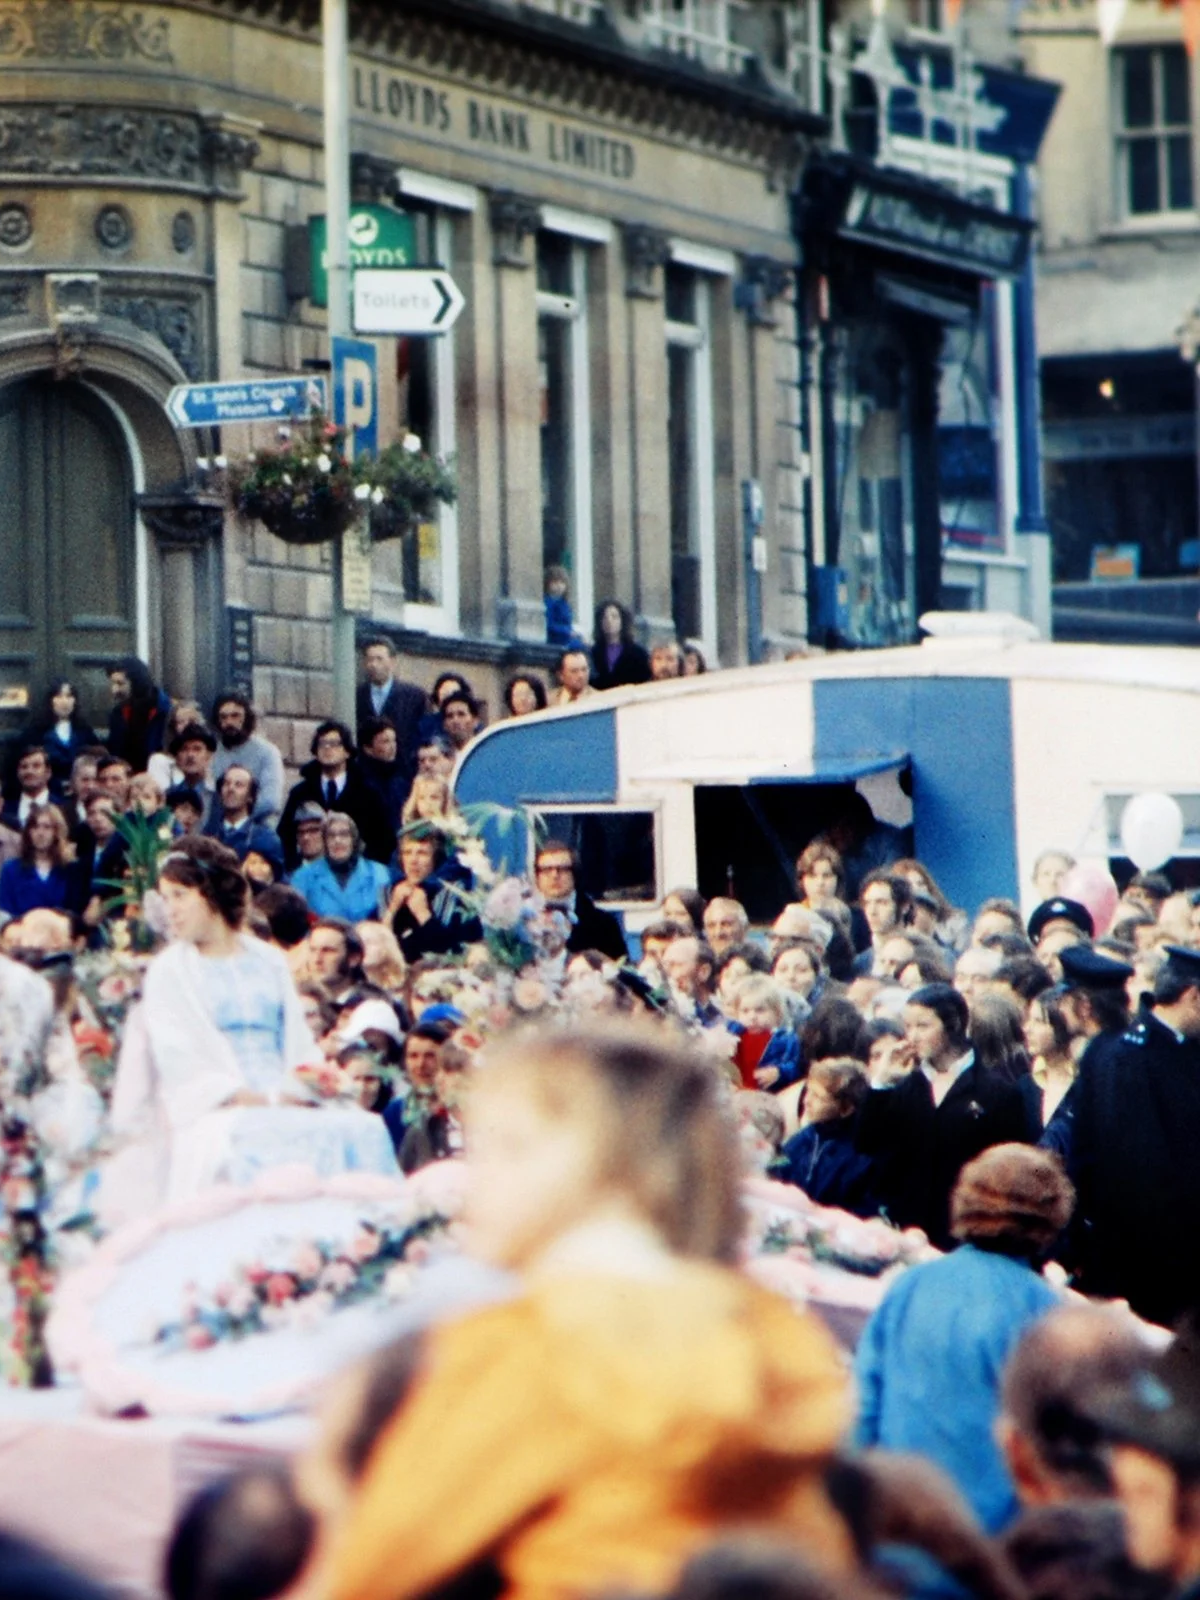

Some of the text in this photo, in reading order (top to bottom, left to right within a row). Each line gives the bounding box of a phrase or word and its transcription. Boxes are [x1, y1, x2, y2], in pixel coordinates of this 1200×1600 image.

[354, 66, 636, 180] LLOYDS BANK LIMITED
[360, 291, 432, 310] Toilets
[343, 357, 372, 465] P
